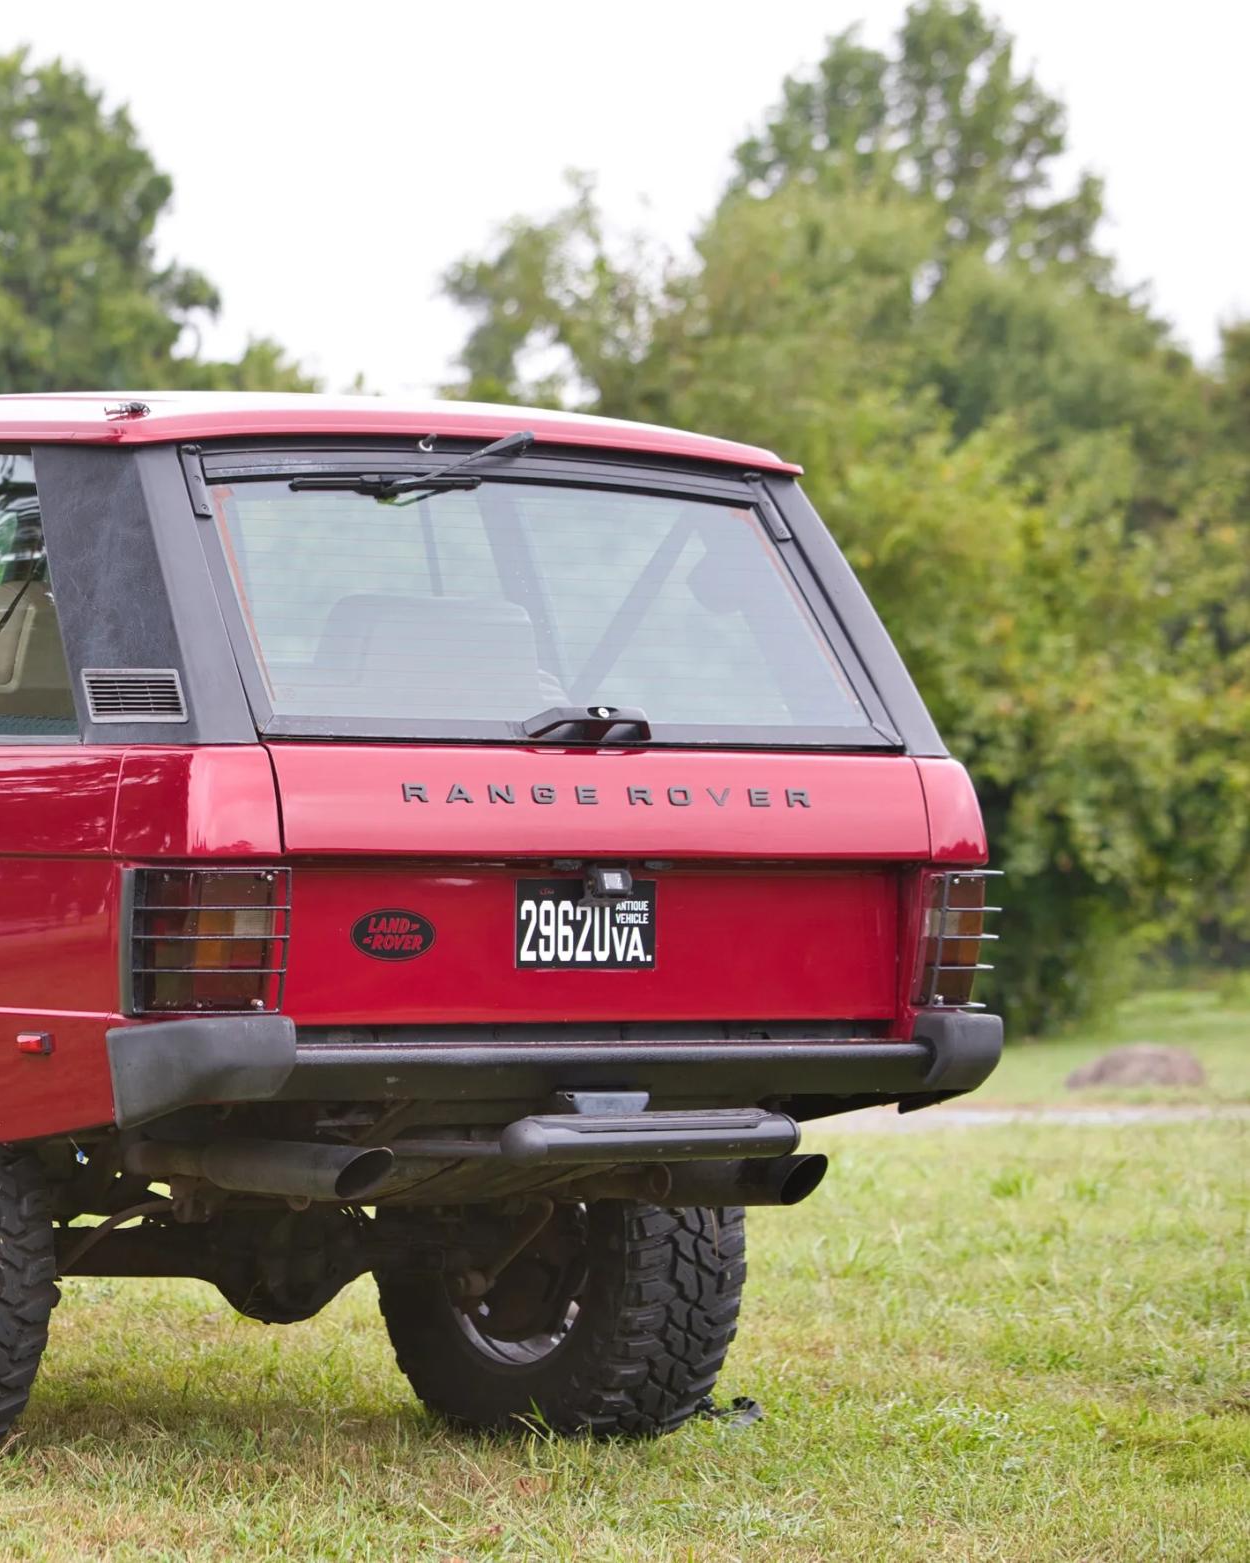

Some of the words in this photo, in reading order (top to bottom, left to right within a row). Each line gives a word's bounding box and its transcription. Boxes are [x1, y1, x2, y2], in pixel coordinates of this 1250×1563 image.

[402, 782, 599, 805] RANGE
[627, 785, 811, 808] ROVER
[616, 900, 649, 911] ANTIQUE
[616, 913, 649, 924] VEHICLE
[520, 900, 610, 961] 2962U
[612, 926, 652, 961] VA.
